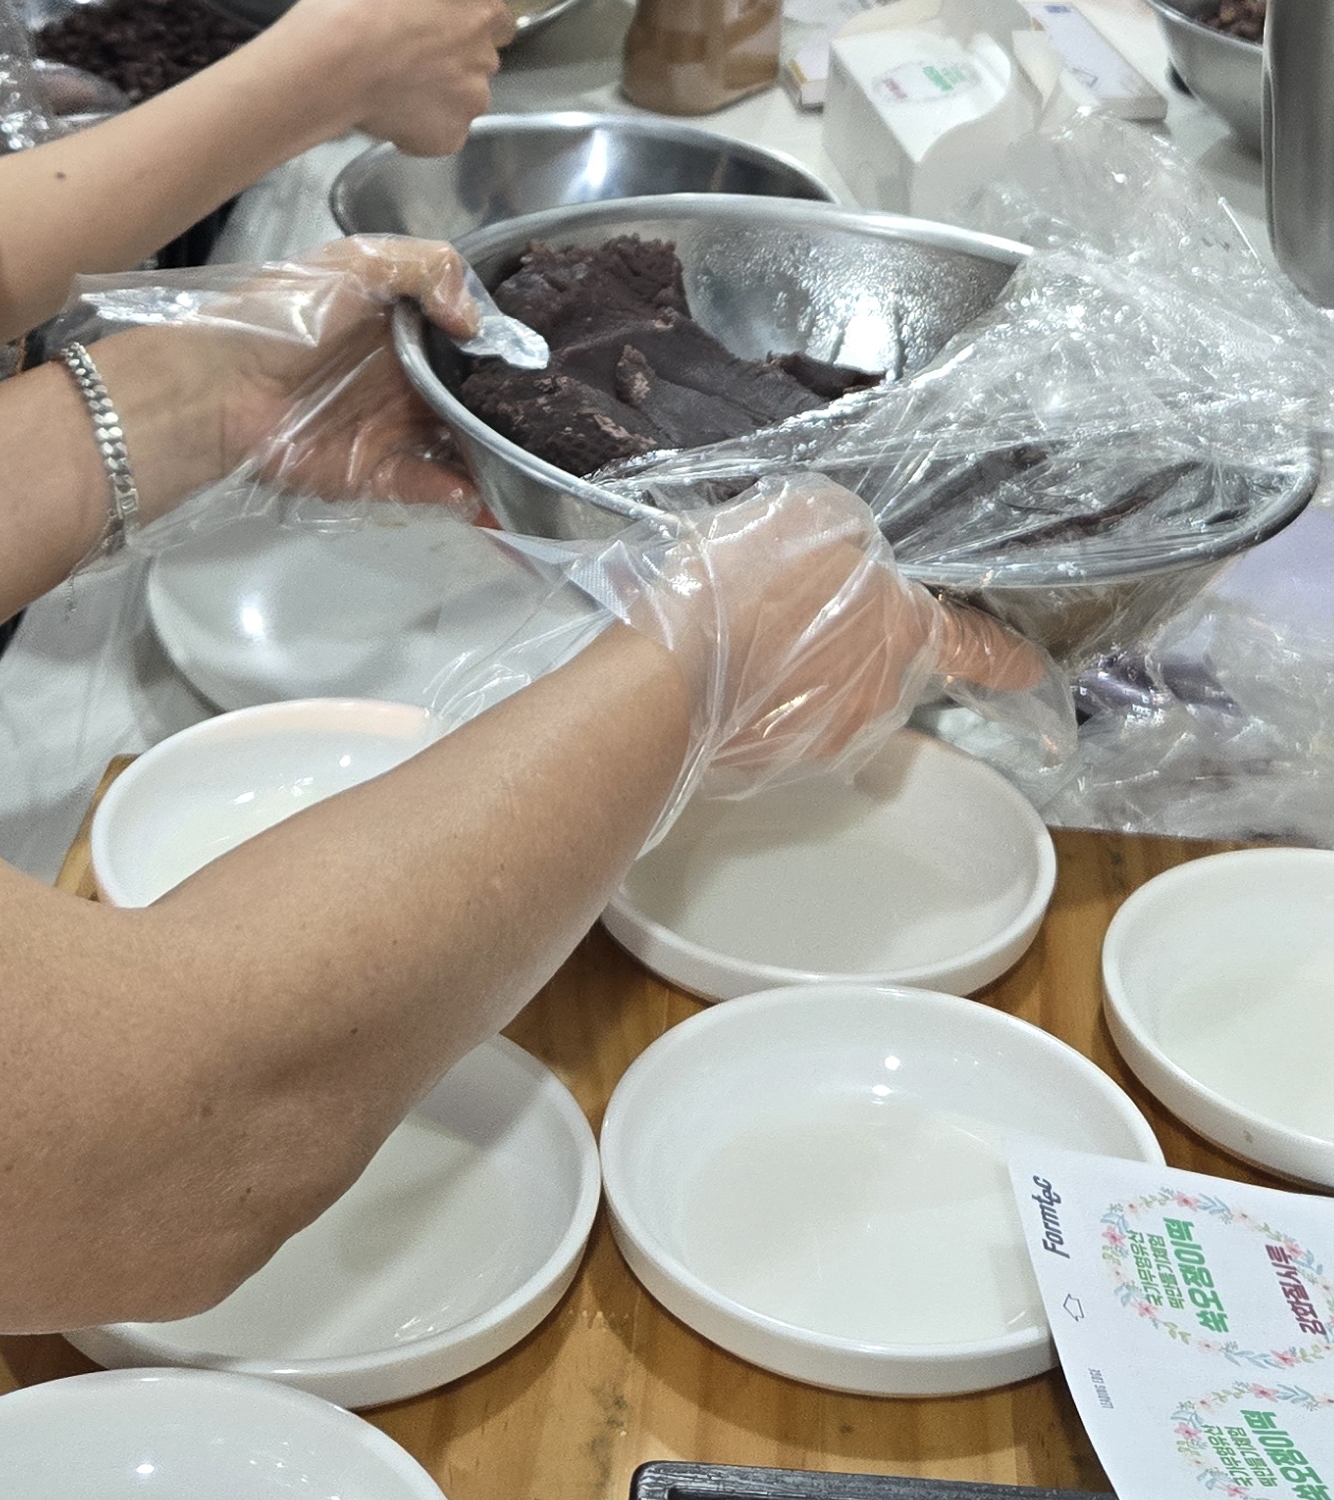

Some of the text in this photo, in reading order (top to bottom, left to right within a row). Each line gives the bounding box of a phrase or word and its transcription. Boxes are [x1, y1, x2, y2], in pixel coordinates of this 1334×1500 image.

[1032, 1175, 1070, 1259] Formtec
[1126, 1229, 1163, 1306] 국가무형유산
[1147, 1233, 1185, 1310] 떡만들기체험
[1163, 1217, 1229, 1333] 쑥오쟁이떡
[1265, 1243, 1327, 1336] 강화질시루
